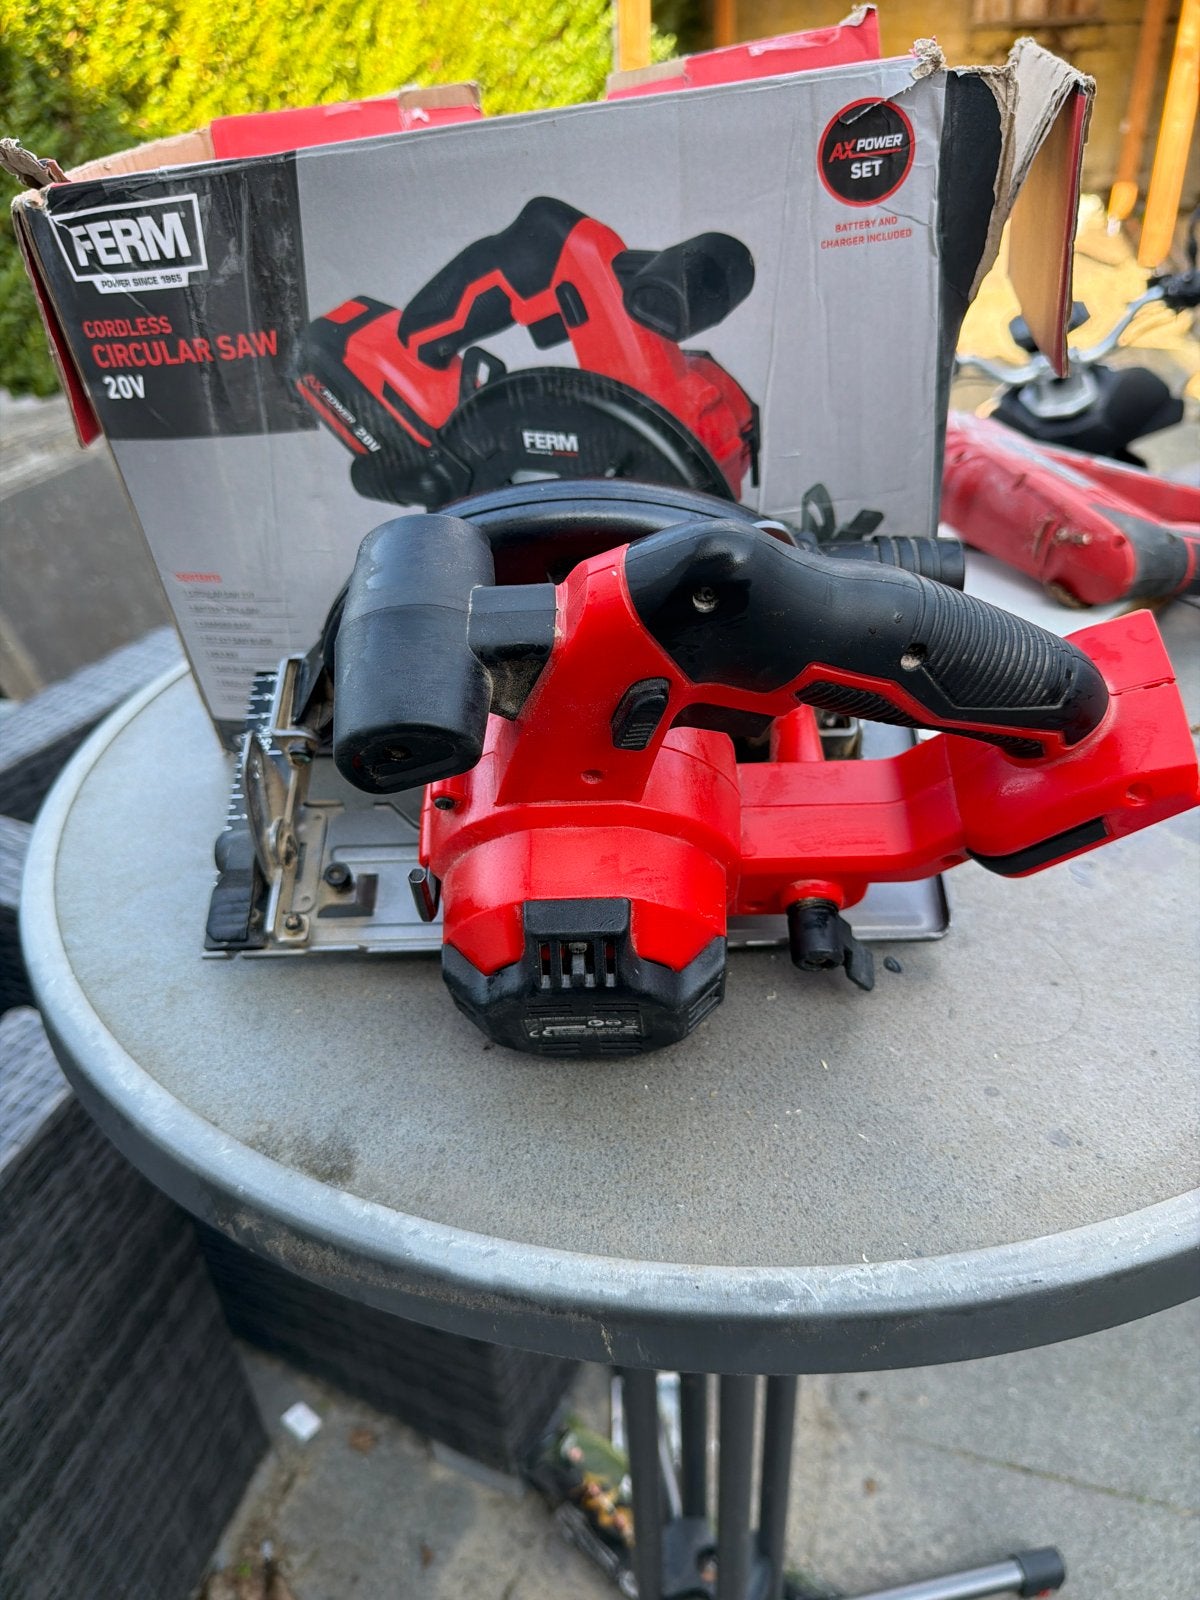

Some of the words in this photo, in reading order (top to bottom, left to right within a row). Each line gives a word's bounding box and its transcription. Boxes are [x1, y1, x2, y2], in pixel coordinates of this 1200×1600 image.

[850, 160, 882, 179] SET
[835, 220, 877, 233] BATTERY
[878, 216, 898, 226] AND
[70, 211, 192, 267] FERM
[821, 235, 865, 249] CHARGER
[867, 228, 912, 243] INCLUDED
[101, 279, 131, 288] POWER
[132, 276, 159, 287] SINCE
[83, 316, 173, 339] CORDLESS
[92, 338, 213, 368] CIRCULAR
[216, 331, 278, 361] SAW
[103, 375, 146, 400] 20V
[522, 431, 578, 452] FERM
